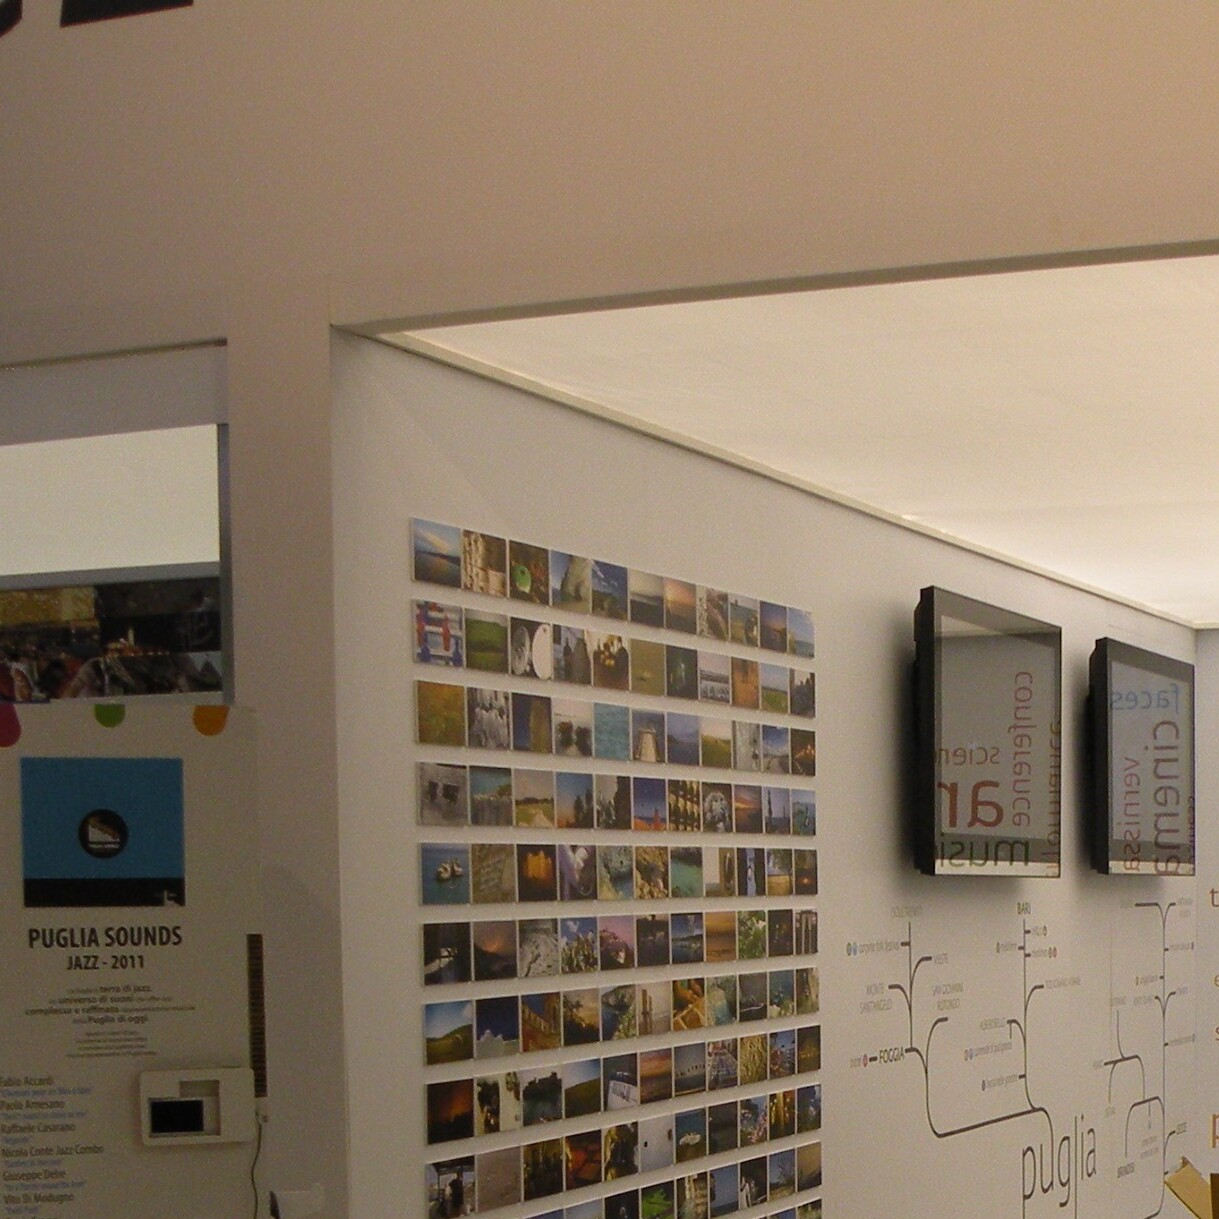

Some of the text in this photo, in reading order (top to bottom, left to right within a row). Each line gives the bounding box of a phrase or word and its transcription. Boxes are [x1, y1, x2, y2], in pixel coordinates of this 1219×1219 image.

[28, 926, 183, 948] PUGLIA SOUNDS
[67, 955, 144, 970] JAZZ 2011
[1022, 1113, 1098, 1208] puglia
